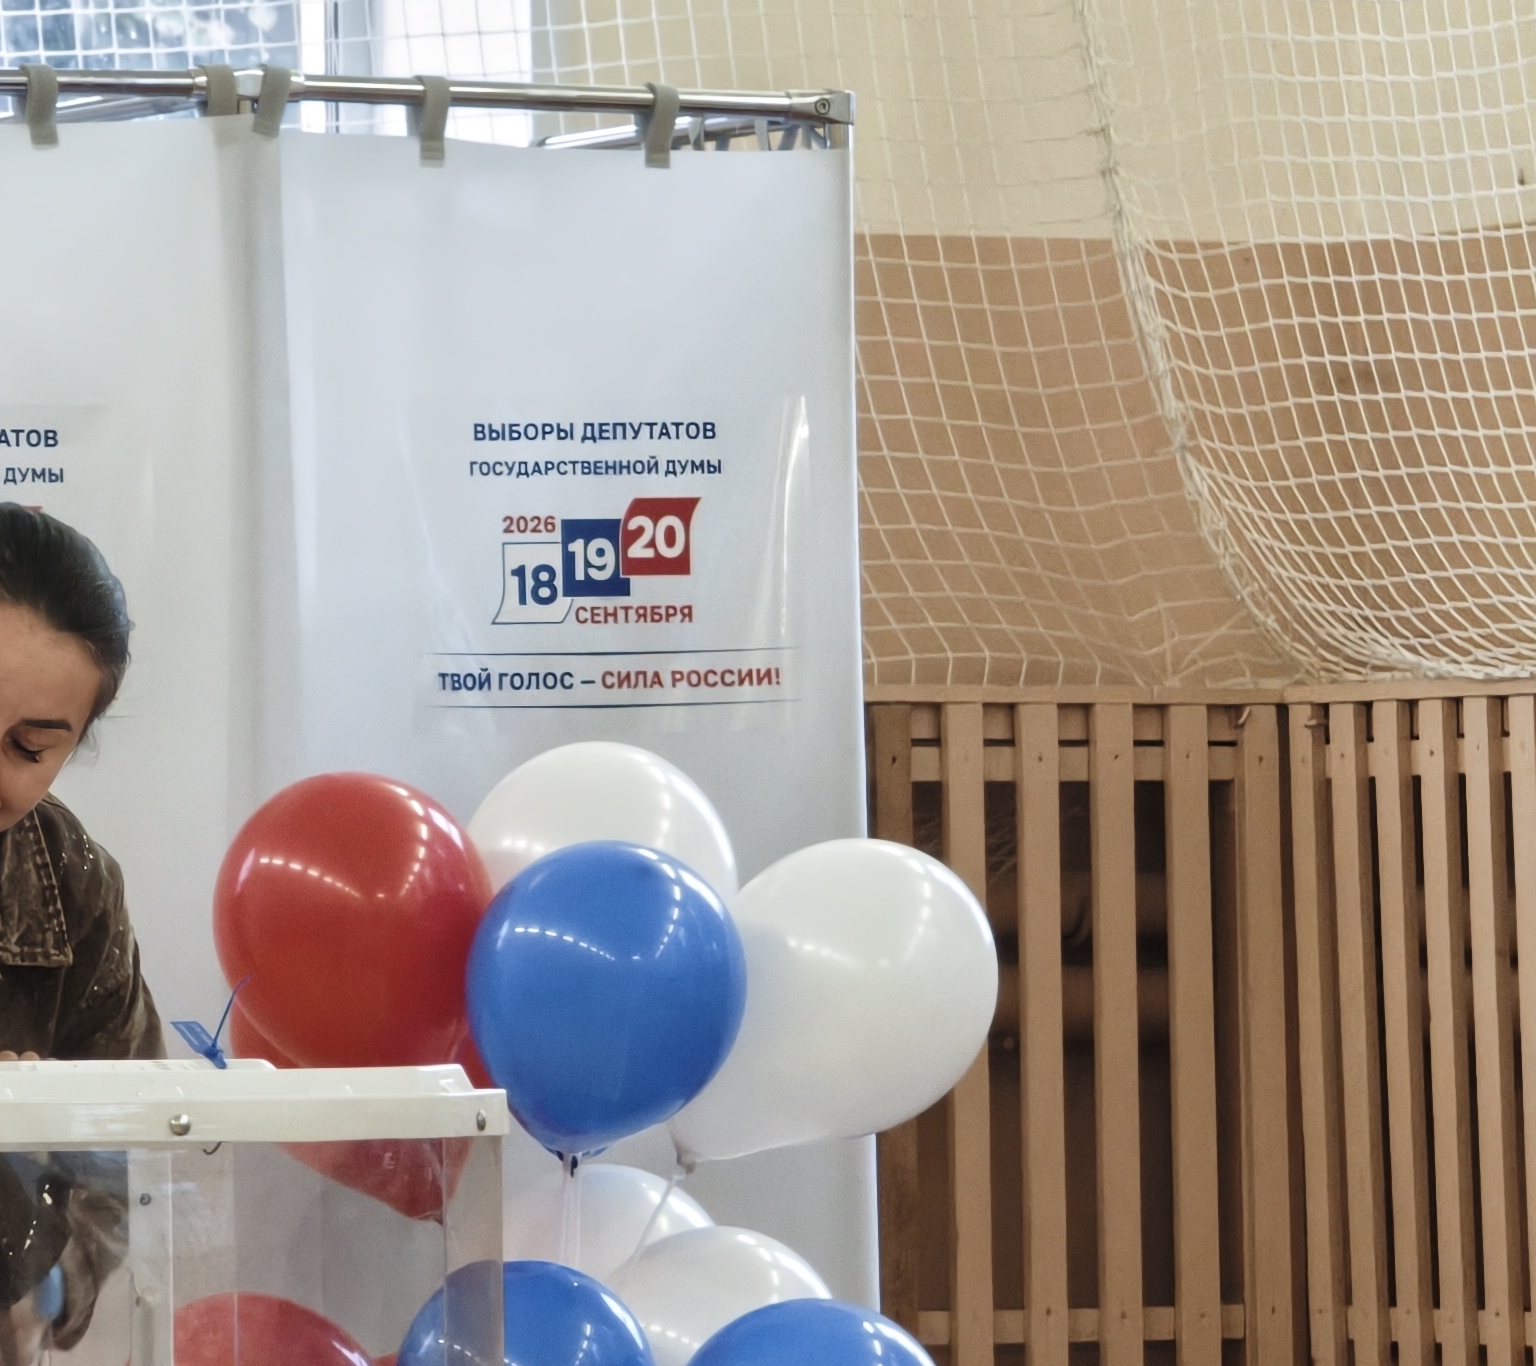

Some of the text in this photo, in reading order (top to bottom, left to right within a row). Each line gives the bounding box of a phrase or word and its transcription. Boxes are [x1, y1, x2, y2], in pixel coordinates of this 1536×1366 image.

[473, 422, 716, 443] ВЫБОРЫ ДЕПУТАТОВ
[4, 467, 64, 485] ДУМЫ
[469, 456, 722, 477] ГОСУДАРСТВЕННОЙ ДУМЫ
[502, 516, 556, 533] 2026
[511, 515, 685, 605] 18 19 20
[575, 604, 693, 624] СЕНТЯБРЯ
[438, 667, 492, 691] ТВОЙ
[498, 671, 574, 691] ГОЛОС
[601, 670, 663, 690] СИЛА
[671, 667, 780, 688] РОССИИ!
